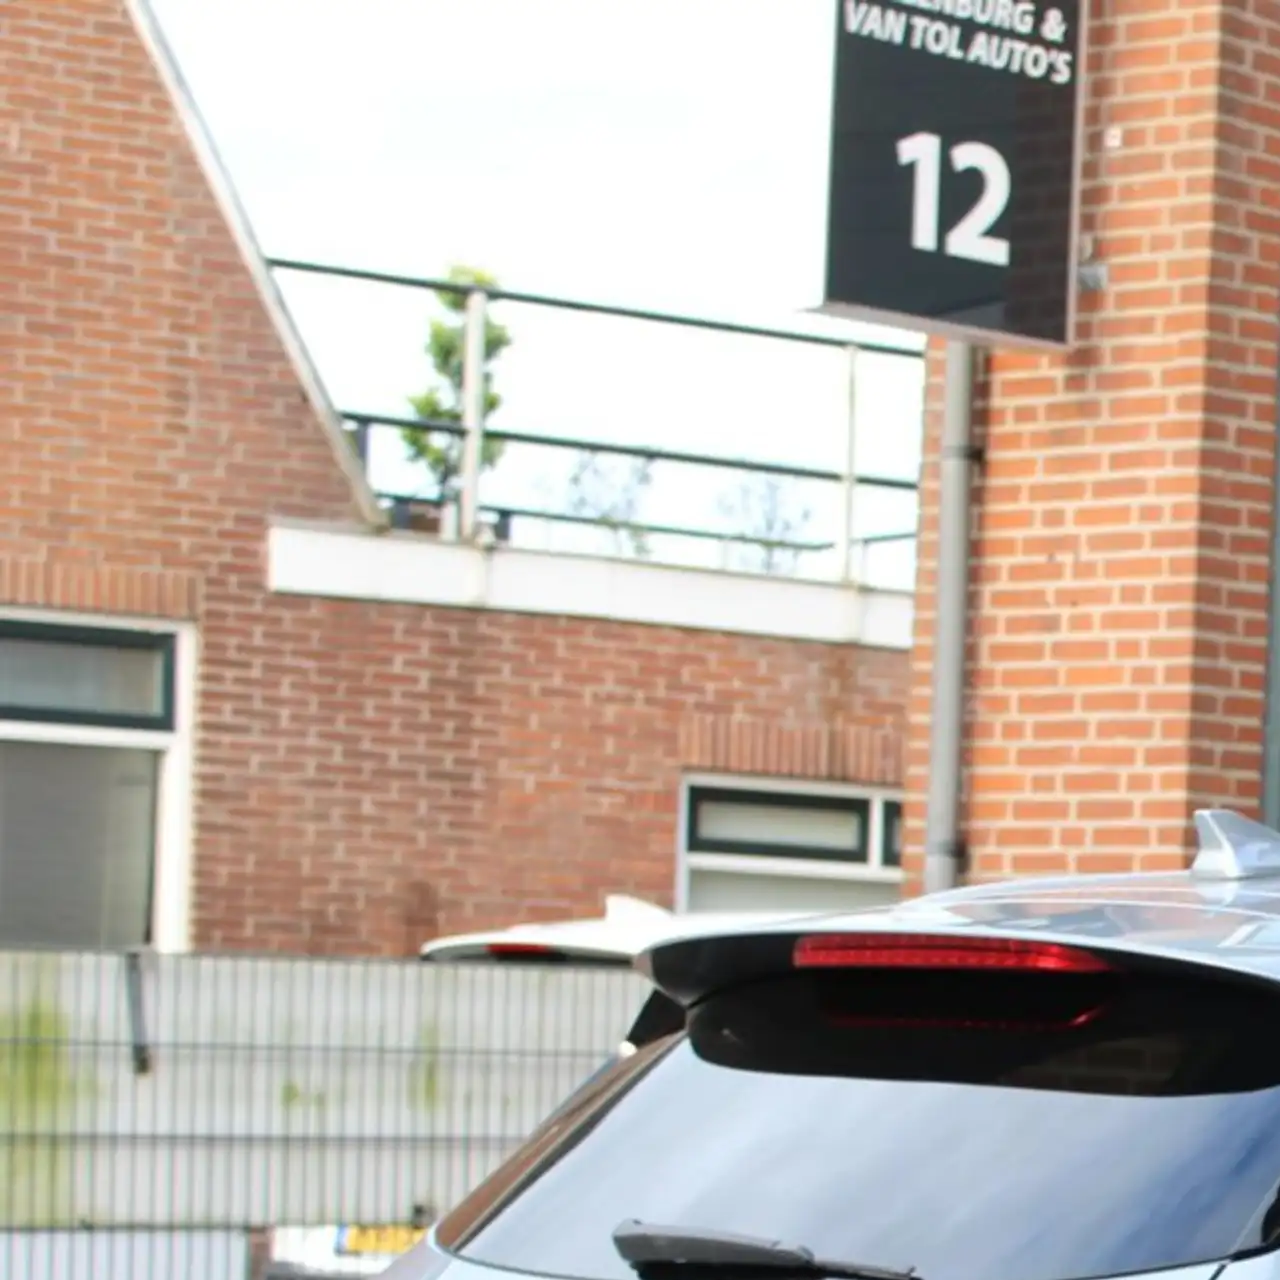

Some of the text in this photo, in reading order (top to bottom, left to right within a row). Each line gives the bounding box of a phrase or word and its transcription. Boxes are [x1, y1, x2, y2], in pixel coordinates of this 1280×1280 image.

[844, 2, 1072, 84] VAN TOL AUTO'S
[1040, 8, 1068, 43] &
[896, 131, 1012, 267] 12
